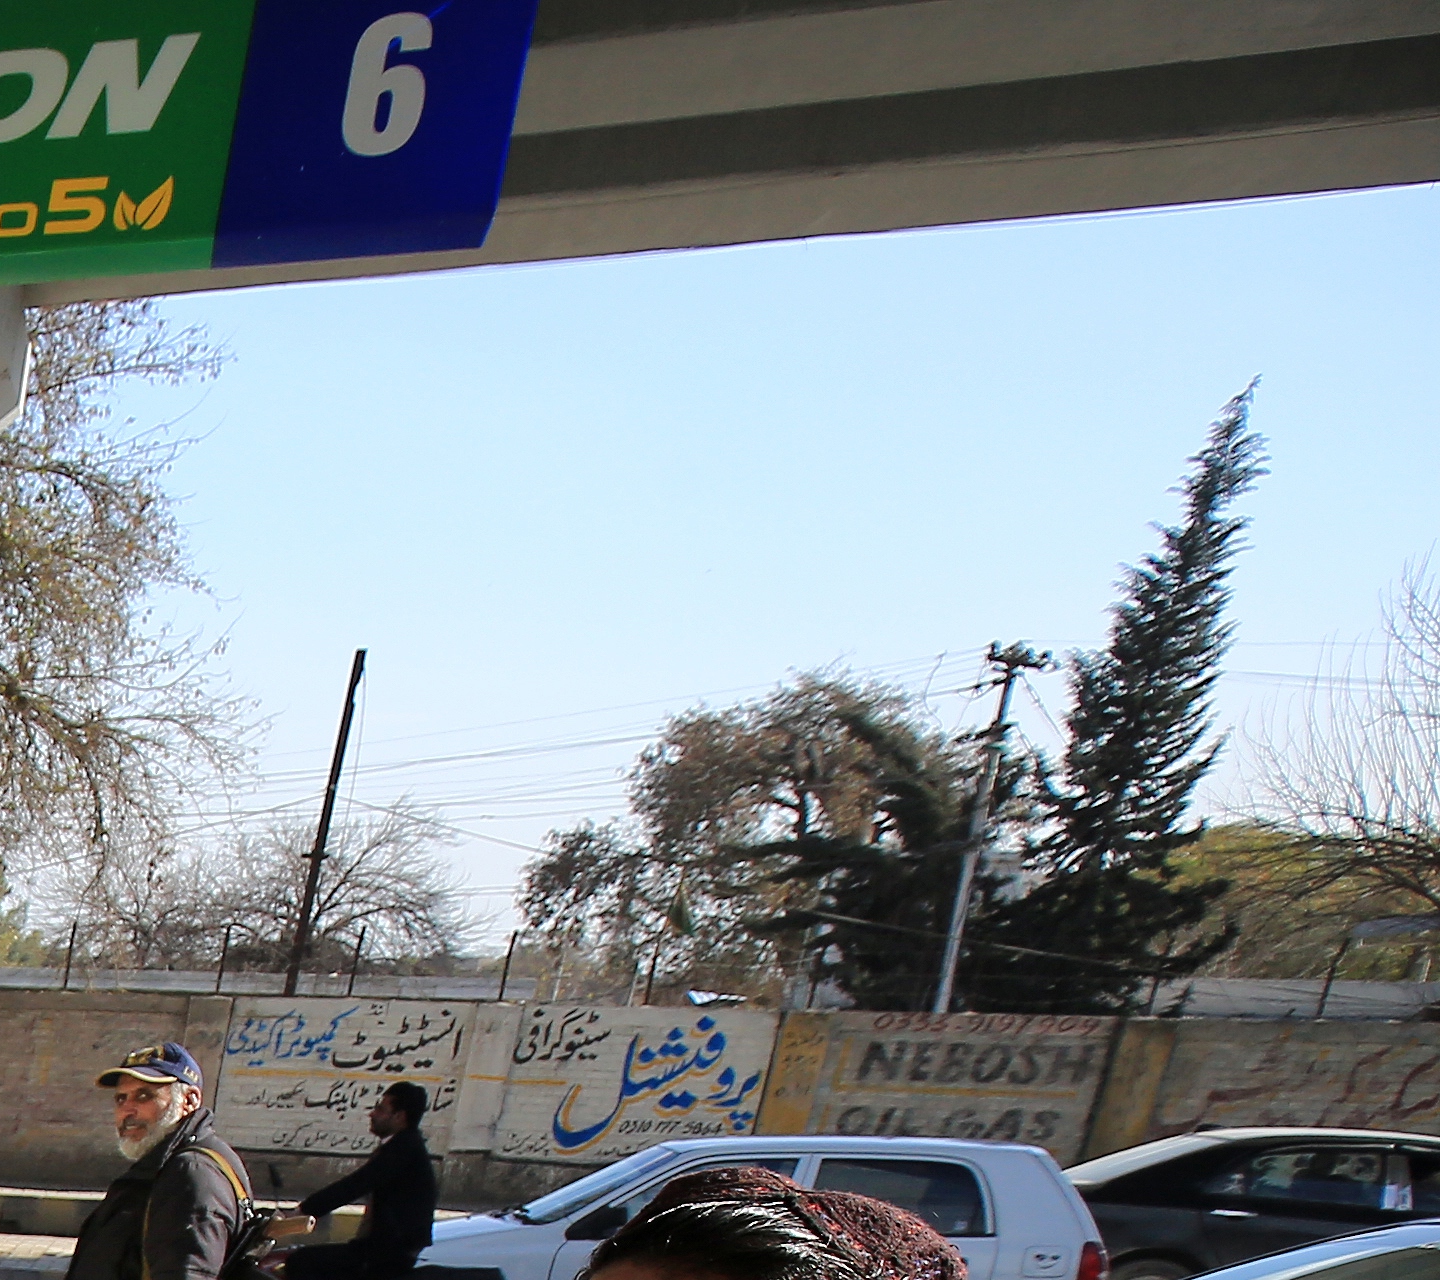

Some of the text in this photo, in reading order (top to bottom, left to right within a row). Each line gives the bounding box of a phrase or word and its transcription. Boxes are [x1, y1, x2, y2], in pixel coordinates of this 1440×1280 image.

[340, 11, 432, 157] 6
[226, 1007, 296, 1066] اکیڈمی
[277, 1005, 360, 1062] کمپیوٹر
[856, 1040, 1095, 1085] NEBOSH
[552, 1015, 763, 1150] پروفیشنل
[837, 1106, 1064, 1140] OIL GAS
